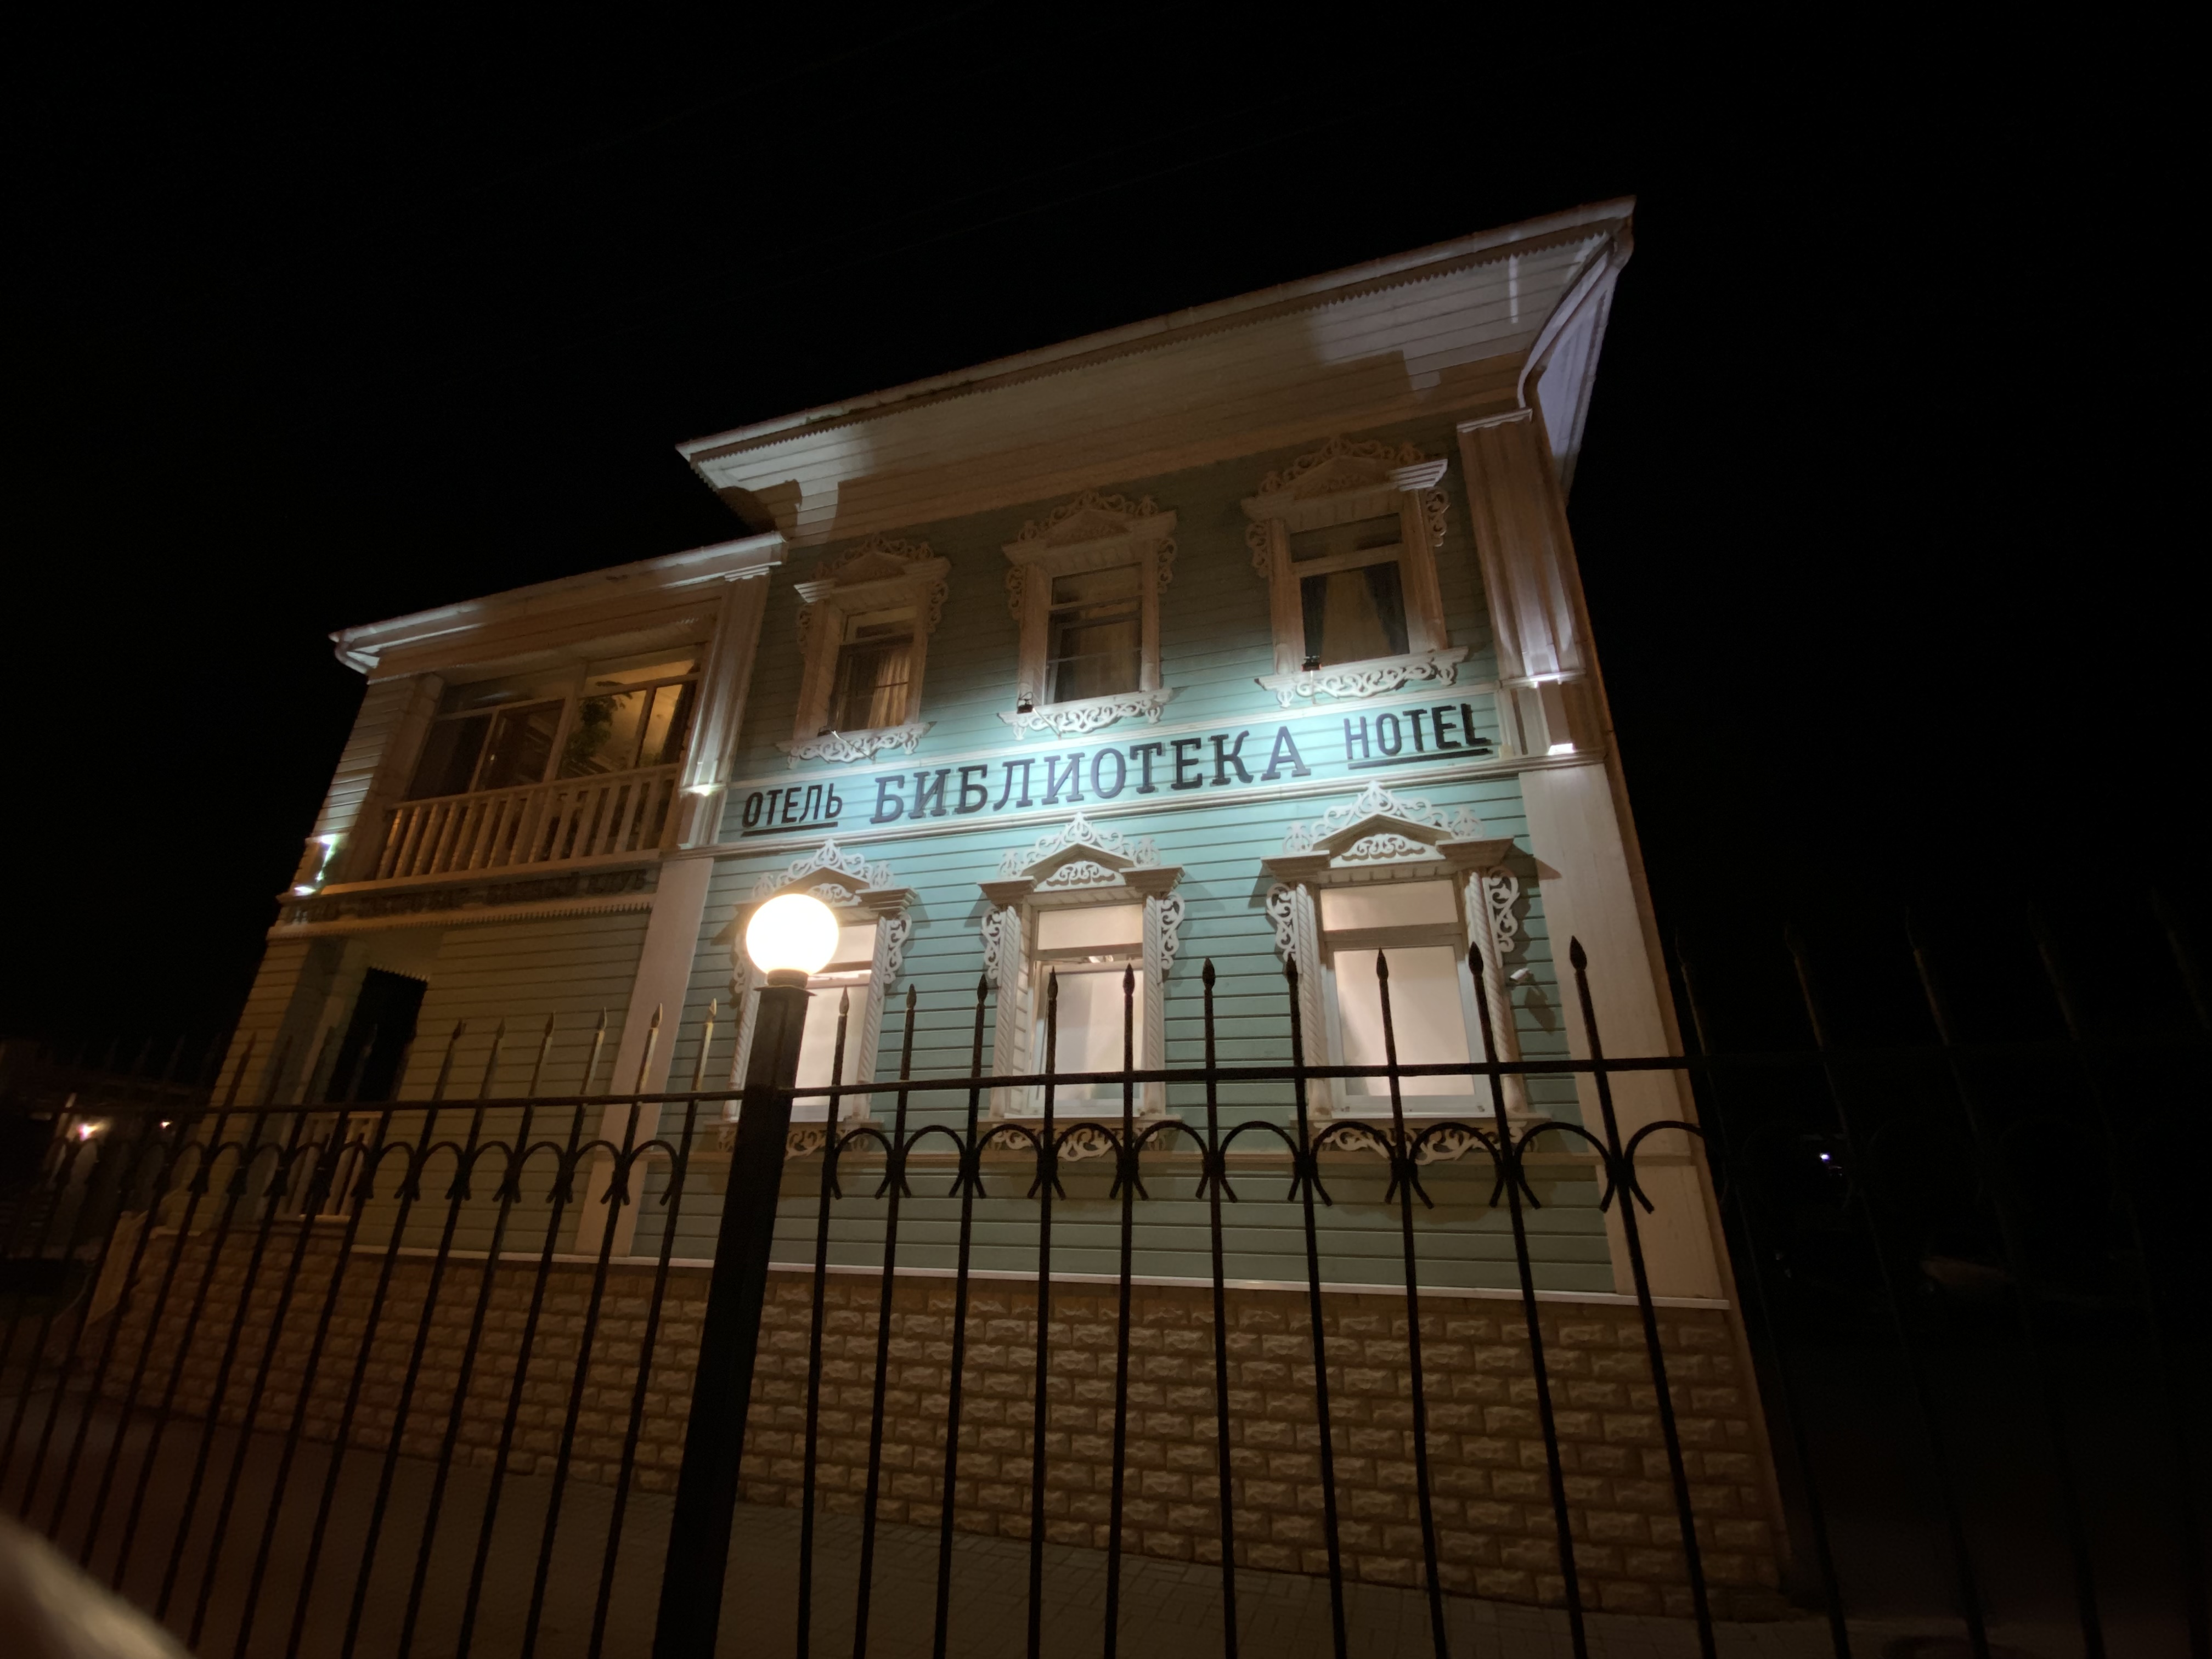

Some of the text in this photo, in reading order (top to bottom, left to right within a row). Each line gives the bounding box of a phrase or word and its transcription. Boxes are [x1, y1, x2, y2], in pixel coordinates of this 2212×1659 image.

[1344, 703, 1488, 760] HOTEL
[742, 726, 1311, 828] ОТЕЛЬ БИБЛИОТЕКА
